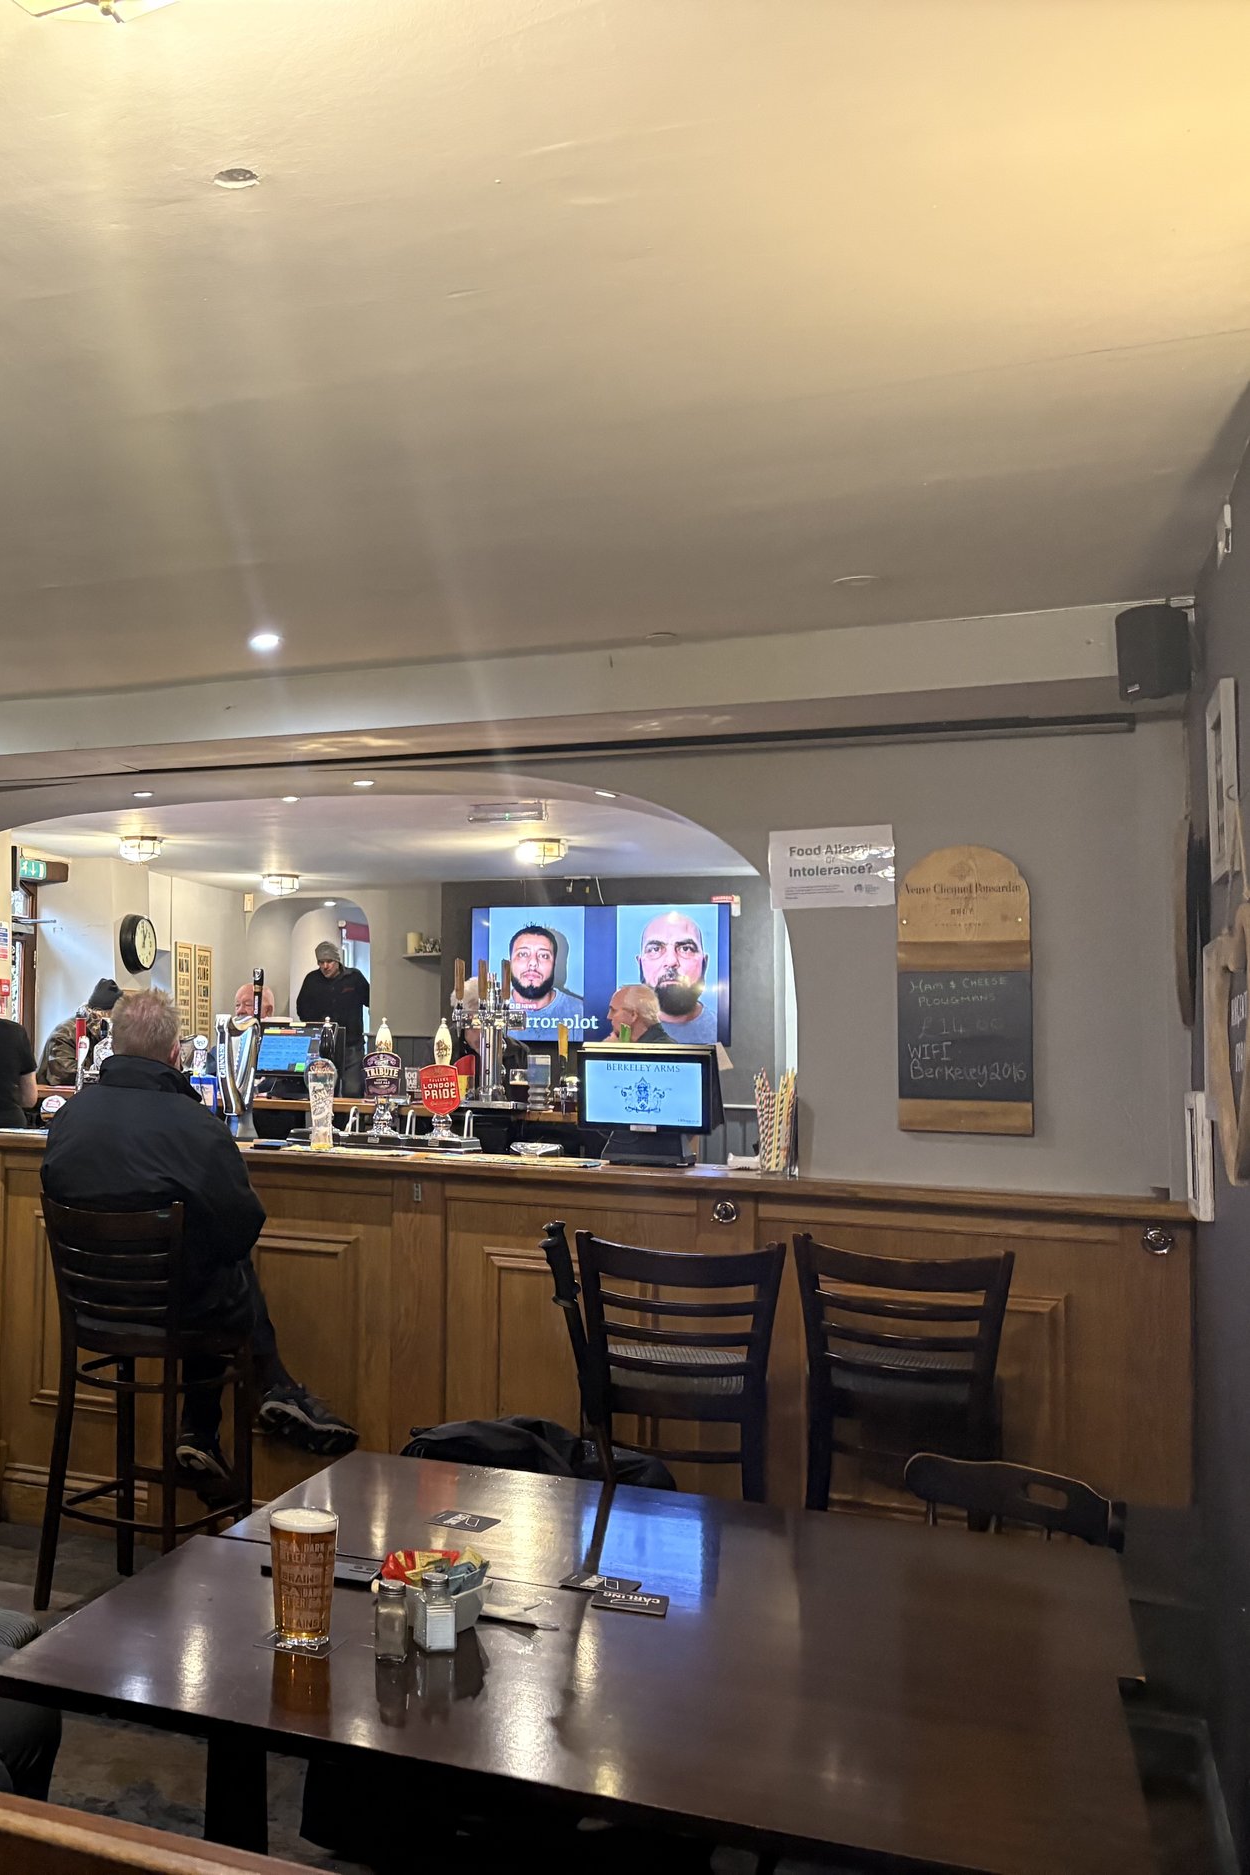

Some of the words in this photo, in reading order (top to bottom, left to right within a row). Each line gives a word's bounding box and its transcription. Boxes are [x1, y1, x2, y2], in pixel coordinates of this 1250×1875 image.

[789, 846, 821, 857] Food
[825, 856, 836, 864] or
[789, 863, 873, 878] Intolerance?
[562, 1014, 599, 1030] plot
[907, 1041, 952, 1061] WIFI
[218, 1043, 227, 1079] GUINNESS
[365, 1068, 399, 1077] TRIBUTE
[606, 1063, 651, 1072] BERKELEY
[654, 1065, 681, 1073] ARMS
[424, 1089, 457, 1100] PRIDE
[602, 1591, 661, 1604] CARLING
